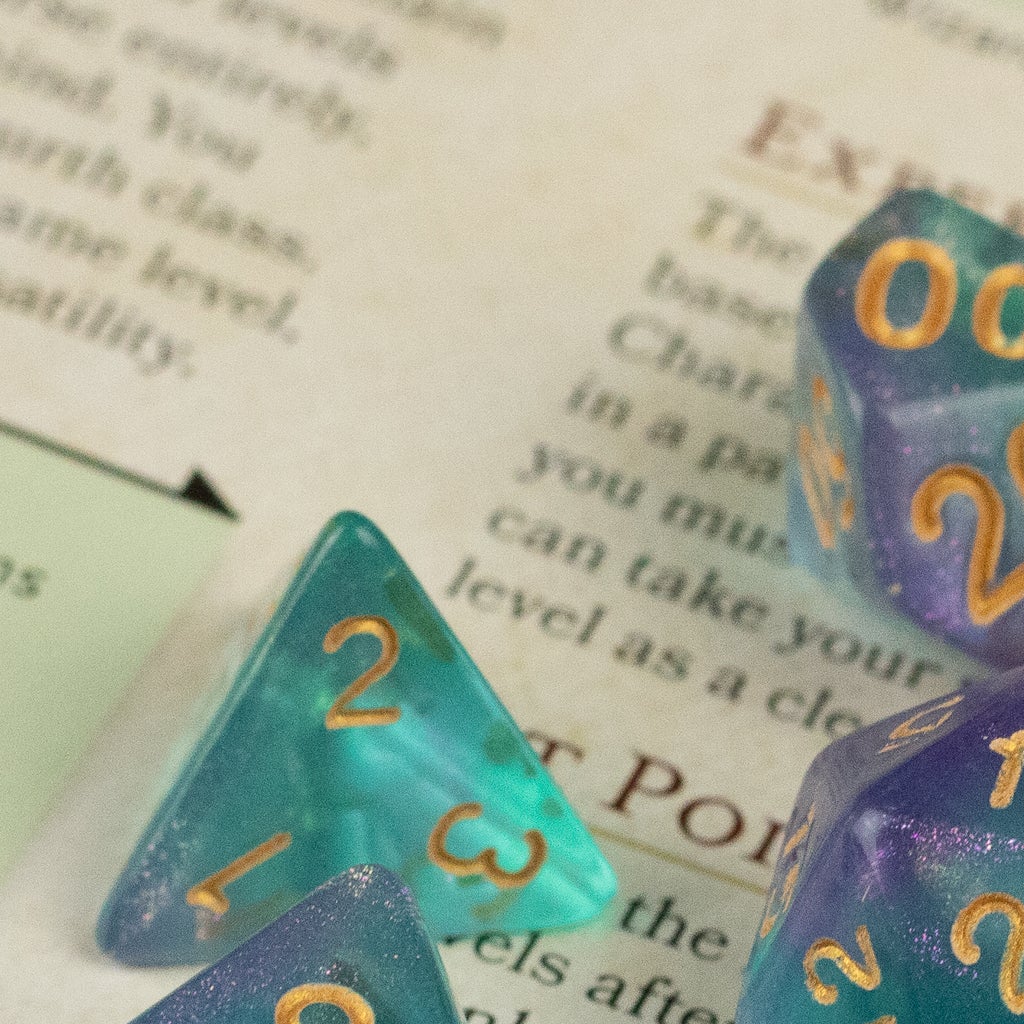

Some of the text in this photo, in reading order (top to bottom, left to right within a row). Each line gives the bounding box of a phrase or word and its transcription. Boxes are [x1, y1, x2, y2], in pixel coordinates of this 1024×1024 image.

[515, 441, 646, 510] you
[444, 555, 604, 647] level
[611, 629, 692, 682] as
[706, 664, 748, 705] a
[484, 503, 607, 573] can
[623, 550, 769, 631] take
[771, 612, 946, 689] your
[322, 615, 401, 731] 2
[186, 831, 293, 914] 1
[427, 802, 549, 889] 3
[442, 930, 572, 988] els
[619, 891, 731, 963] the
